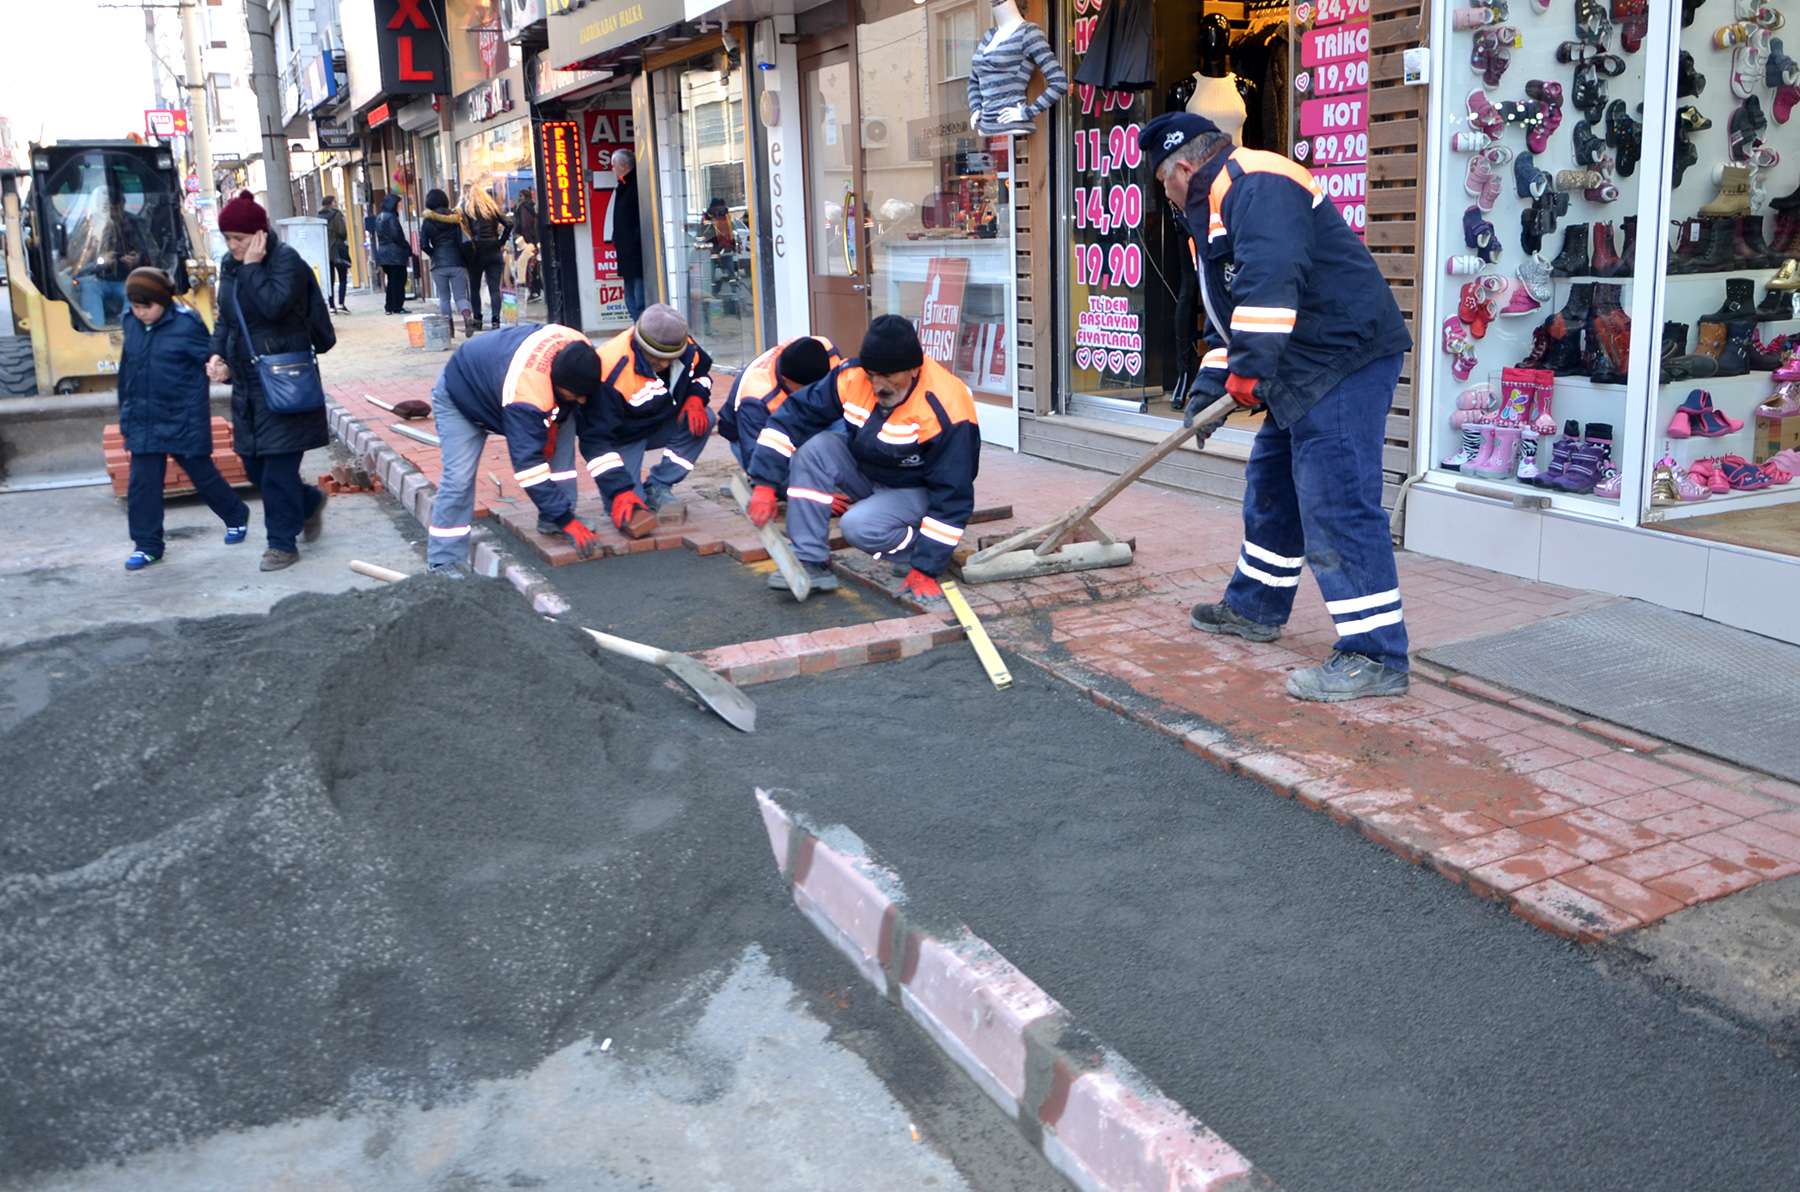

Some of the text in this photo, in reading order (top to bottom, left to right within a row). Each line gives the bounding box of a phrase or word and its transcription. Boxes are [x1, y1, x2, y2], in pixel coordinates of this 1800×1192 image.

[619, 4, 644, 28] HALKA
[1314, 26, 1369, 60] TRİKO
[1317, 60, 1368, 92] 19,90
[1322, 101, 1361, 127] KOT
[1074, 123, 1142, 177] 11,90
[1314, 133, 1368, 162] 29,90
[554, 126, 573, 219] PERADİL
[771, 142, 785, 258] esse
[1074, 183, 1142, 235] 14,90
[1074, 243, 1142, 290] 19,90
[1088, 295, 1128, 313] TL'DEN
[1079, 311, 1139, 332] BAŞLAYAN
[921, 328, 955, 362] YARISI
[1076, 328, 1141, 351] FİYATLARLA
